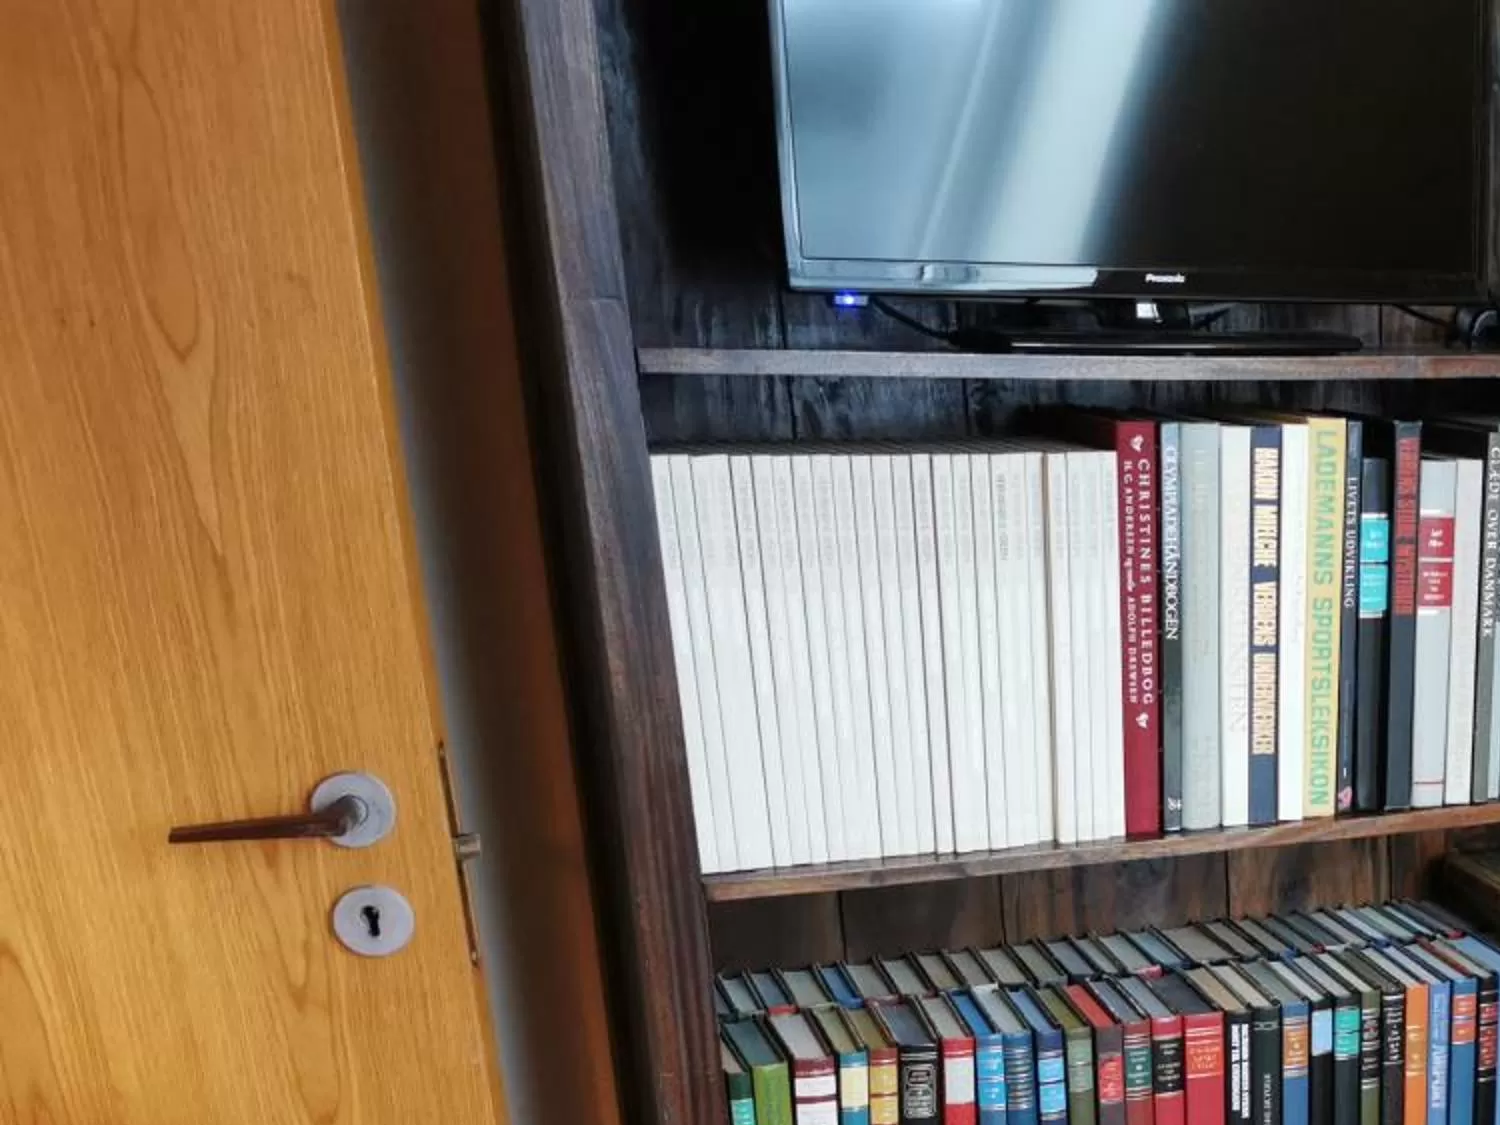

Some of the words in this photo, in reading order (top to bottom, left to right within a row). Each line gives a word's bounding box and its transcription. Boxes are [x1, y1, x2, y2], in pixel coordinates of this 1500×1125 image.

[1255, 447, 1278, 499] HAKON
[1313, 429, 1337, 585] LADEMANNS
[1345, 476, 1358, 525] LIVETS
[1124, 487, 1137, 554] ANDERSEN
[1138, 458, 1152, 585] CHRISTINES
[1164, 445, 1180, 641] OLYMPIADEHÅNDBOGEN
[1486, 509, 1499, 550] OVER
[1343, 529, 1356, 609] UDVIKLING
[1481, 556, 1497, 638] DANMARK
[1126, 596, 1138, 643] ADOLPH
[1253, 581, 1276, 646] VERDENS
[1140, 595, 1154, 706] BILLEDBOG
[1309, 597, 1334, 806] SPORTSLEKSIKON
[1431, 1043, 1447, 1109] AIRPORT
